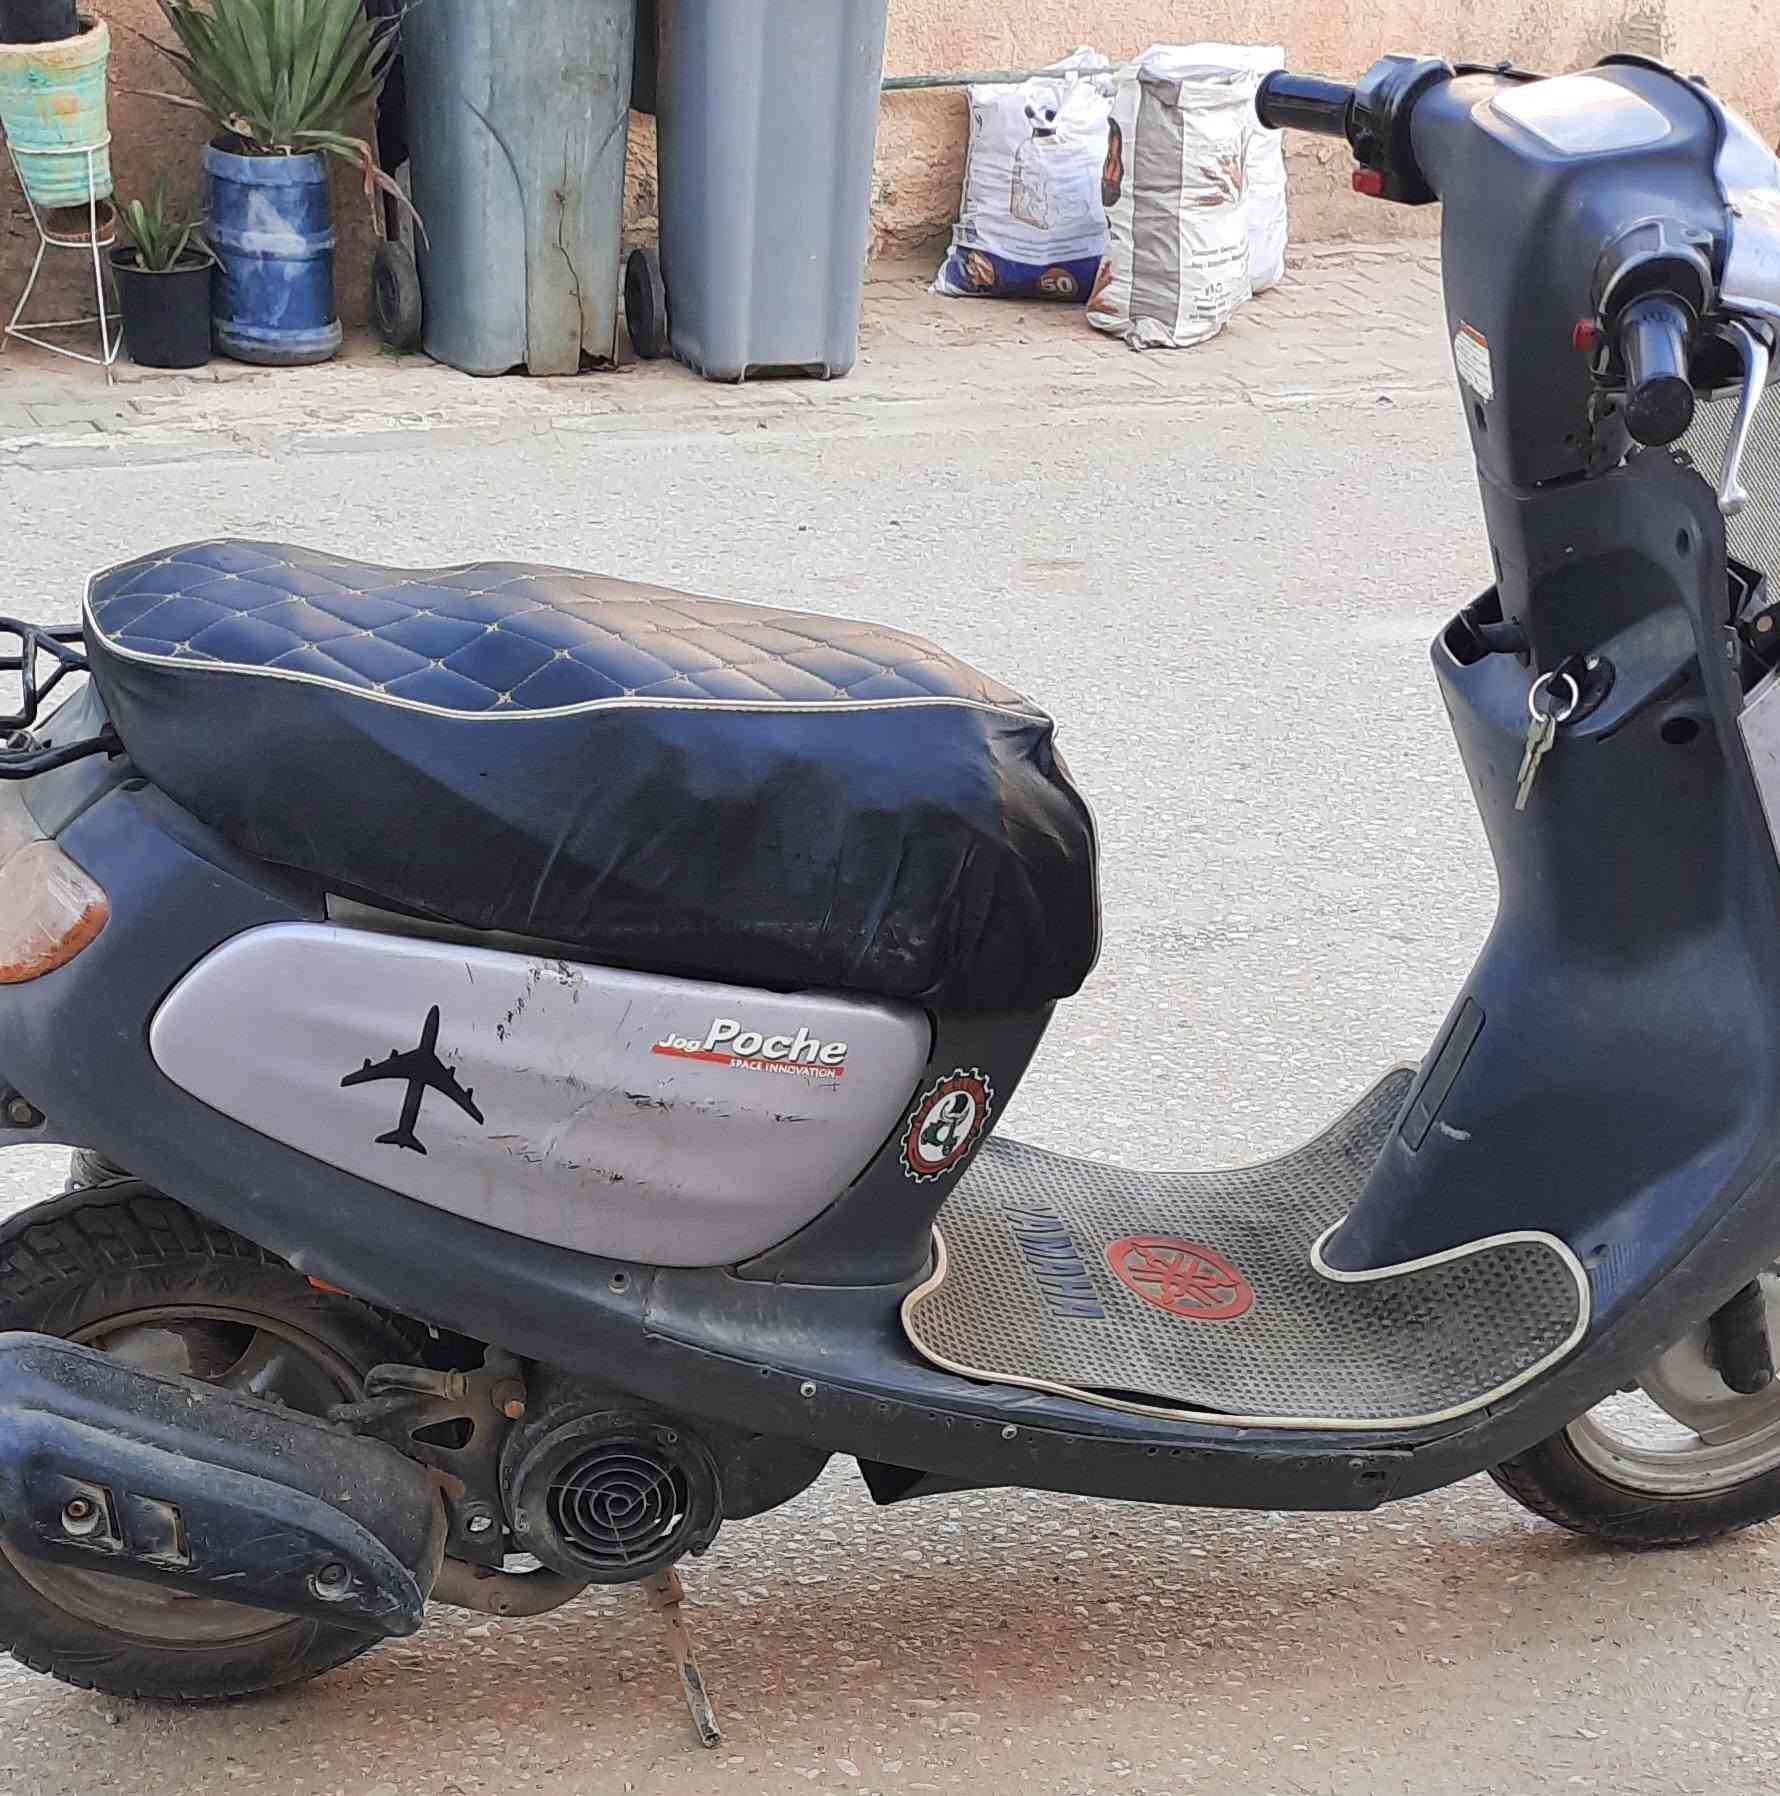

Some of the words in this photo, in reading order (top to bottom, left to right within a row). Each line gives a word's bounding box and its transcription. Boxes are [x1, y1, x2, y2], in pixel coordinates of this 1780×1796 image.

[659, 1032, 703, 1052] Jog
[702, 1017, 848, 1066] Poche
[729, 1058, 763, 1071] SPACE
[765, 1060, 836, 1078] INNOVATION
